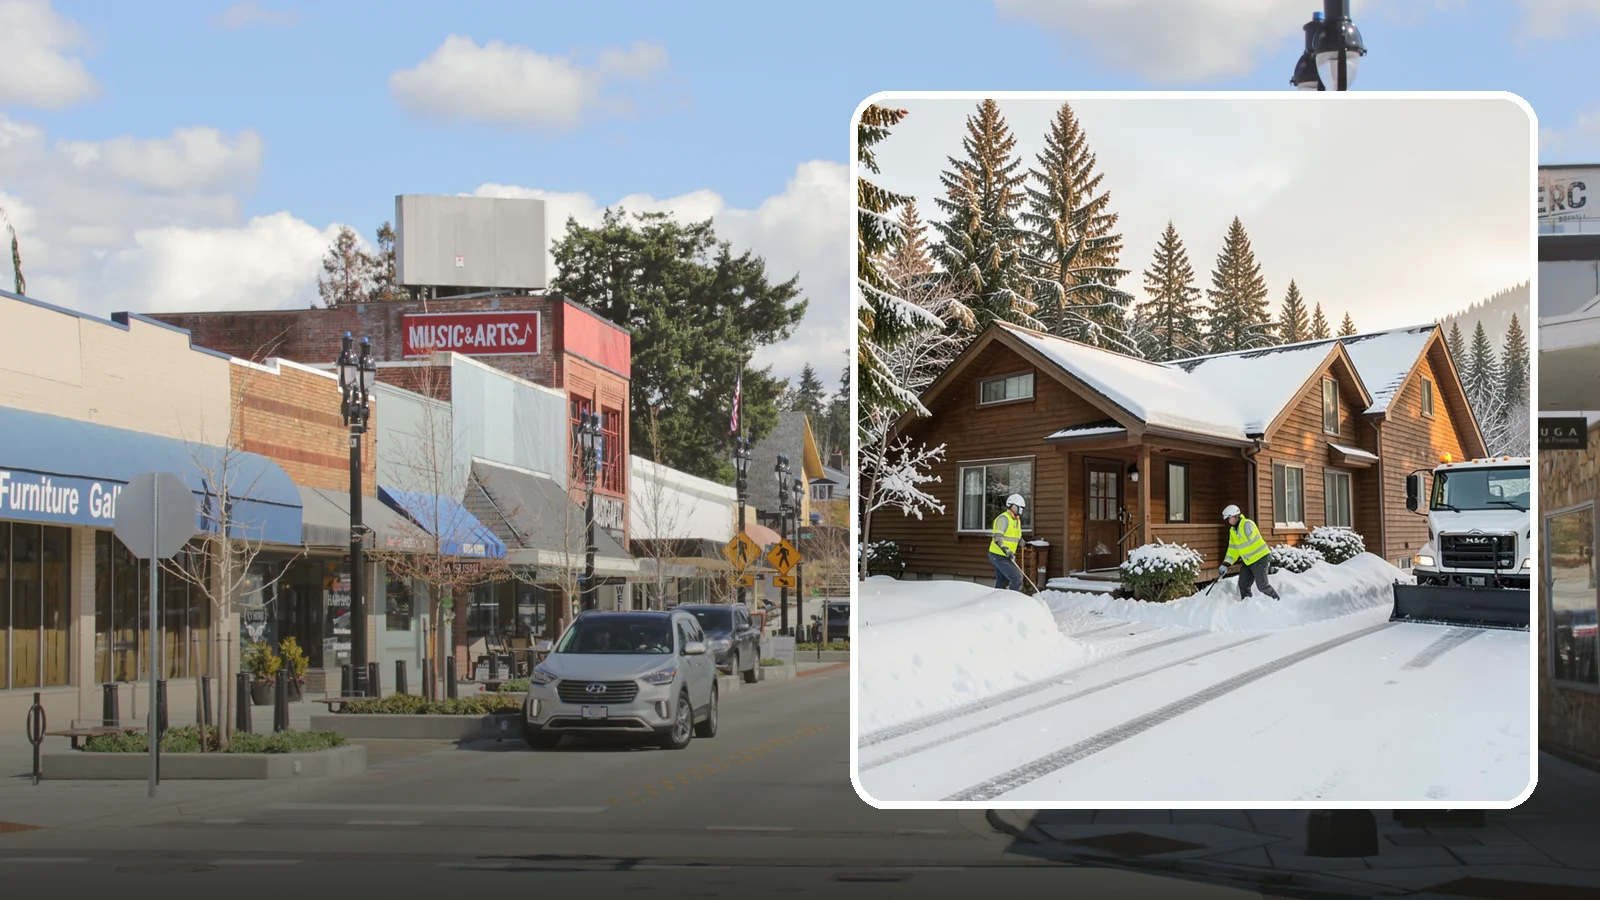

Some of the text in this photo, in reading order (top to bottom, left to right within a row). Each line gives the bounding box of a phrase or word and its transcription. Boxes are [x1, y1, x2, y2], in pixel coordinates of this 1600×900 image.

[409, 322, 519, 349] MUSIC&ARTS
[0, 471, 122, 519] Furniture Gal
[453, 563, 479, 574] SUSHI
